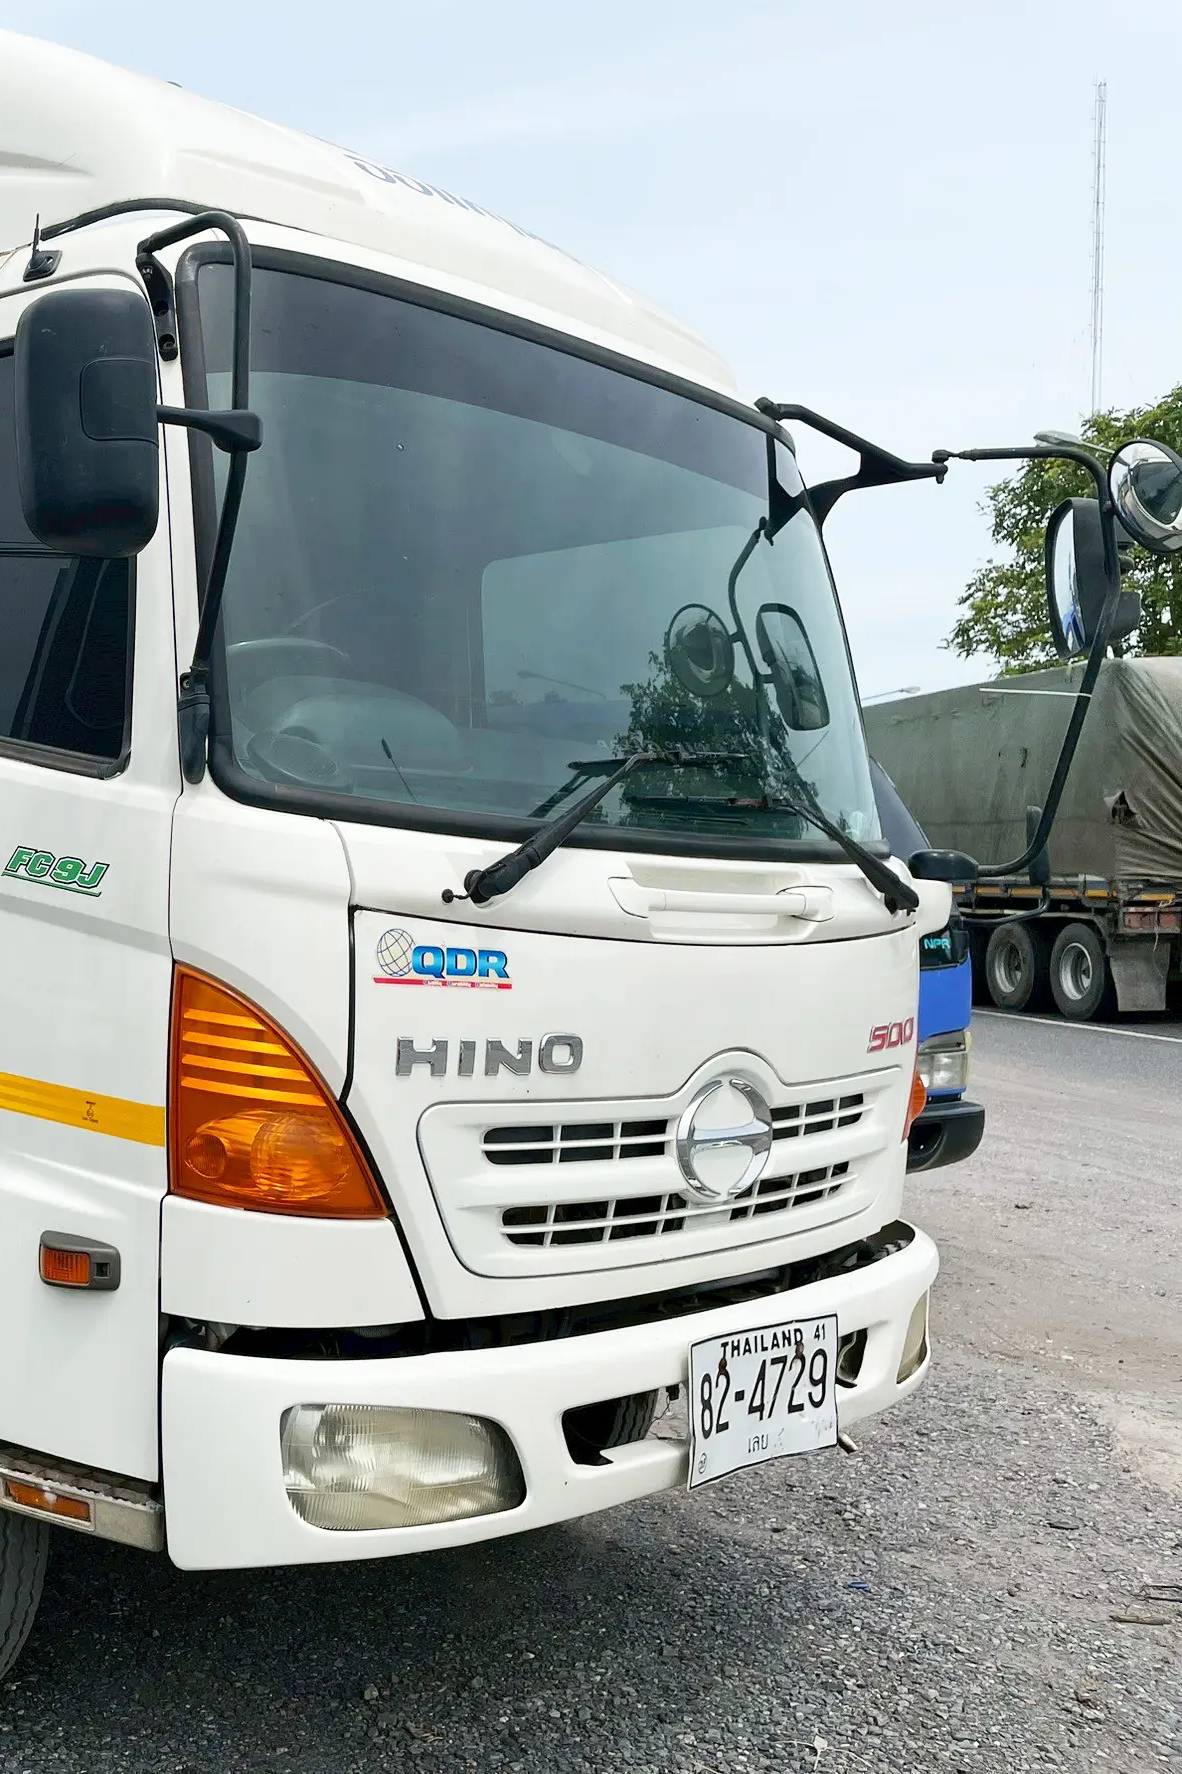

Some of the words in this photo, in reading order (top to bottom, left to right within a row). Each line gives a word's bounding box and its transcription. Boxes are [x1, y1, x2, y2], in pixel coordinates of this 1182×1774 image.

[5, 845, 110, 889] FC9J
[924, 938, 951, 950] NPR
[412, 945, 510, 979] QDR
[867, 1017, 914, 1053] 500
[395, 1031, 584, 1077] HINO
[721, 1328, 804, 1358] THAILAND
[814, 1323, 826, 1341] 41
[700, 1348, 828, 1440] 82-4729
[747, 1433, 769, 1454] เลย
